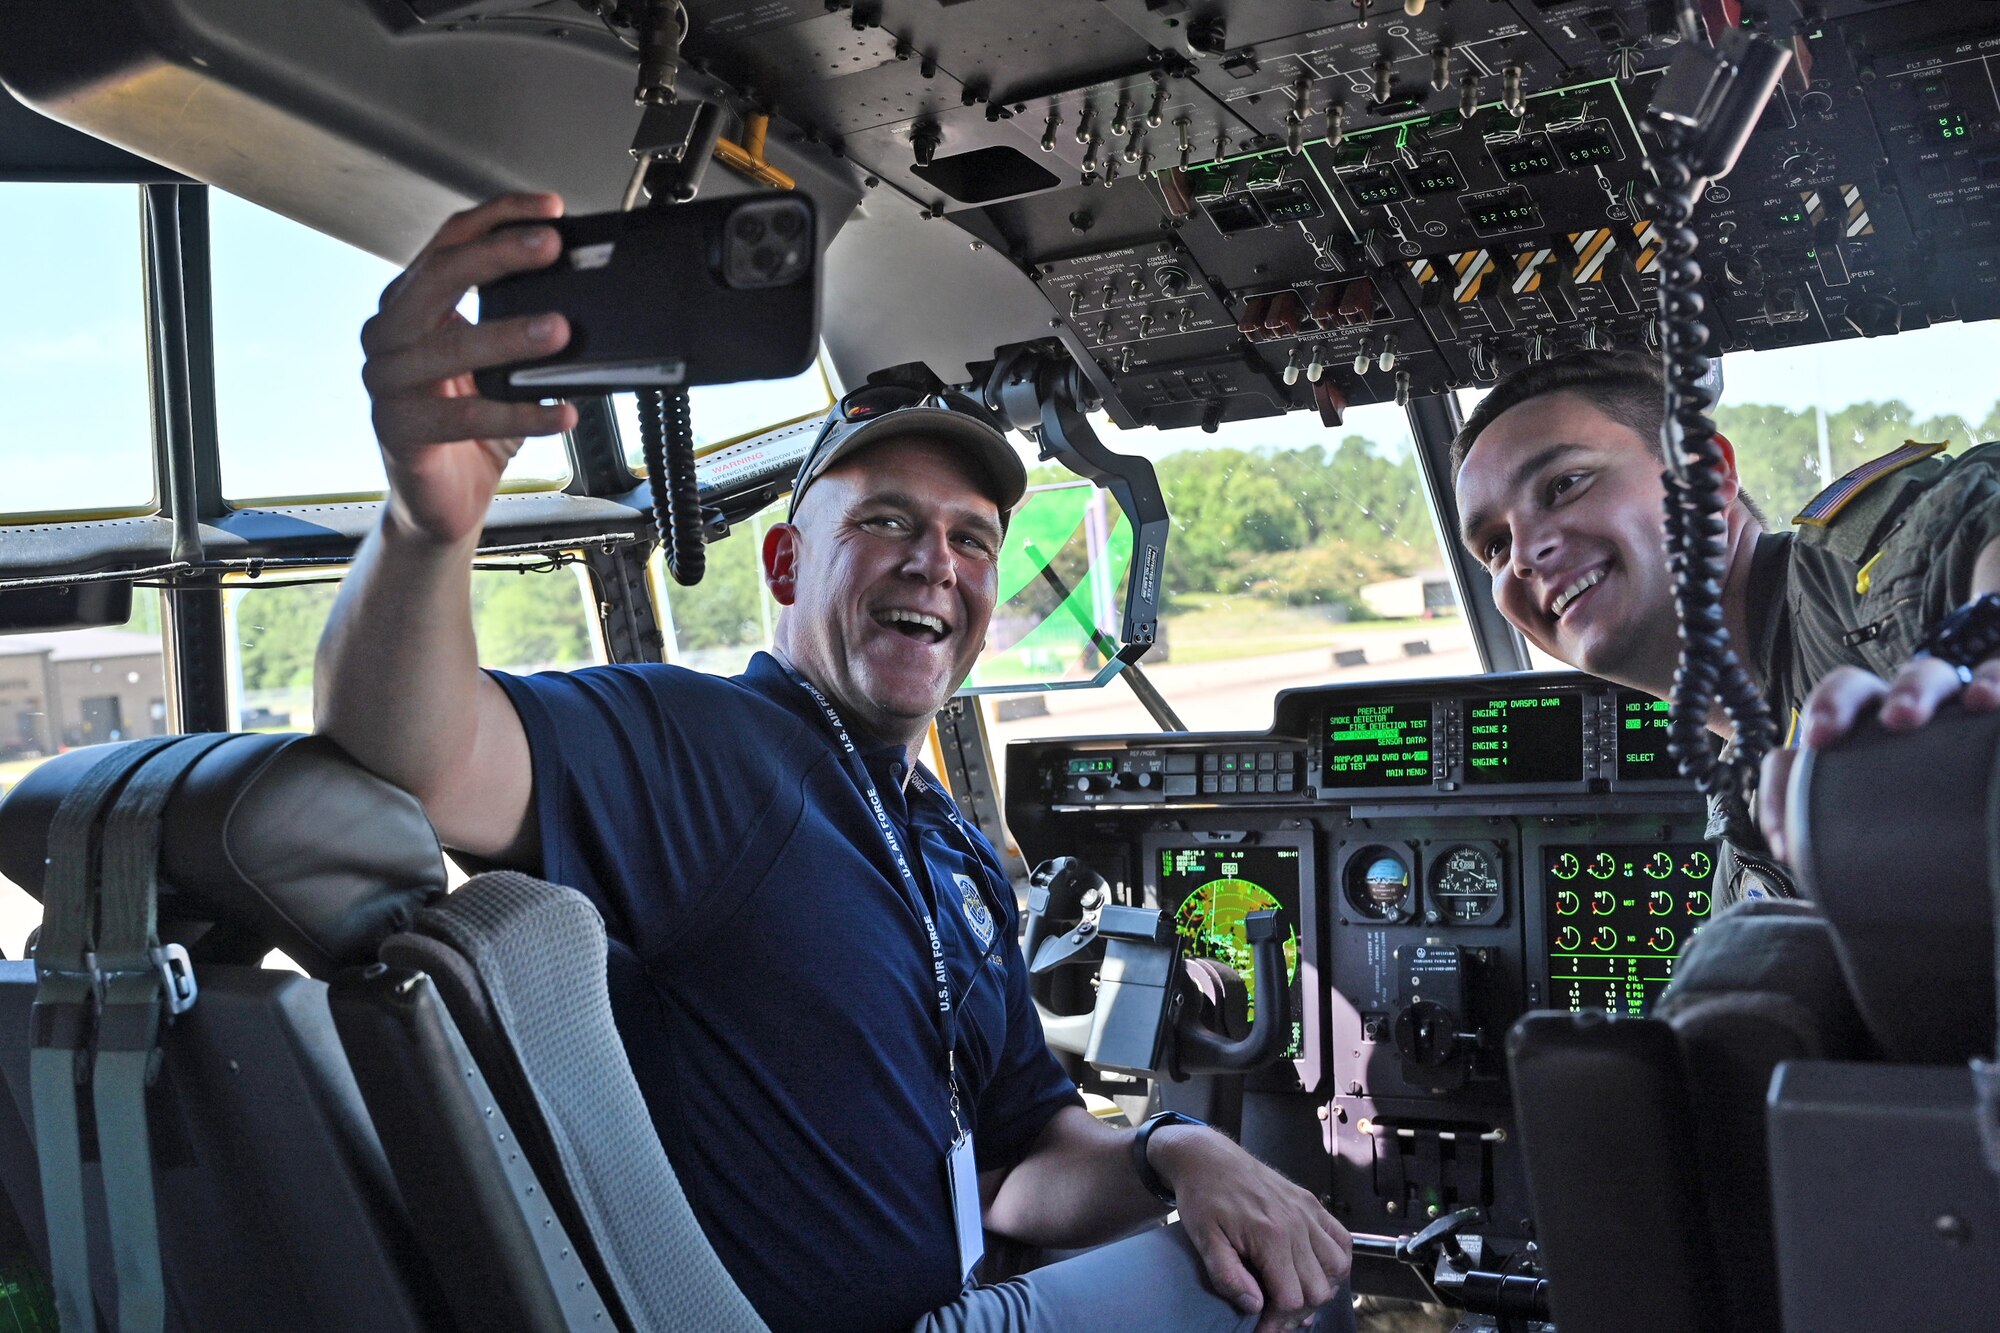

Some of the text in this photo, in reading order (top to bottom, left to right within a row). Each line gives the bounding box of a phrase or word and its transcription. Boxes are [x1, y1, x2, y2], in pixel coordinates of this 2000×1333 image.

[1306, 28, 1335, 38] BLEED
[1956, 39, 2000, 53] AIR CON
[1926, 58, 1942, 66] STA
[1913, 69, 1942, 79] POWER
[1928, 103, 1950, 111] TEMP
[1390, 109, 1428, 119] PRESSURE
[1943, 127, 1963, 138] 60
[1570, 146, 1611, 160] 6840
[1510, 157, 1549, 172] 2090
[1421, 177, 1454, 188] 1850
[1808, 175, 1835, 185] SELECT
[1361, 187, 1397, 200] 6580
[1474, 192, 1496, 200] TOTAL
[1928, 191, 1954, 199] CROSS
[1958, 186, 1981, 194] FLOW
[1763, 199, 1781, 207] APU
[1276, 203, 1310, 214] 7420
[1711, 210, 1735, 218] ALARM
[1519, 241, 1535, 249] FIRE
[1071, 249, 1134, 265] EXTERIOR LIGHTING
[1094, 264, 1125, 272] NAVIGATION
[1291, 280, 1314, 288] FADEC
[1298, 327, 1372, 342] PROPELLER CONTROL
[712, 452, 763, 473] WARNING
[712, 452, 791, 481] OPEN/CLOSE WINDOW
[759, 464, 780, 474] FULLY
[1511, 700, 1538, 708] OVRSPD
[1541, 698, 1560, 706] GVNR
[1626, 703, 1640, 711] HDD
[1357, 706, 1394, 715] PREFLIGHT
[1472, 709, 1507, 717] ENGINE 1
[800, 681, 855, 753] U.S. AIR FORCE
[1330, 715, 1387, 724] SMOKE DETECTOR
[1370, 721, 1406, 730] DETECTION
[1410, 720, 1427, 728] TEST
[1654, 719, 1669, 727] BUS
[1472, 725, 1507, 734] ENGINE 2
[1378, 737, 1403, 746] SENSOR
[1472, 741, 1508, 750] ENGINE 3
[1334, 755, 1363, 763] RAMP/DR
[1366, 754, 1379, 762] WOW
[1382, 753, 1399, 761] OVRD
[1472, 757, 1507, 766] ENGINE 4
[1626, 753, 1654, 762] SELECT
[1386, 769, 1403, 777] MAIN
[910, 771, 929, 794] FORCE
[866, 788, 911, 878] U.S. AIR FORCE
[924, 915, 949, 1012] U.S. AIR FORCE
